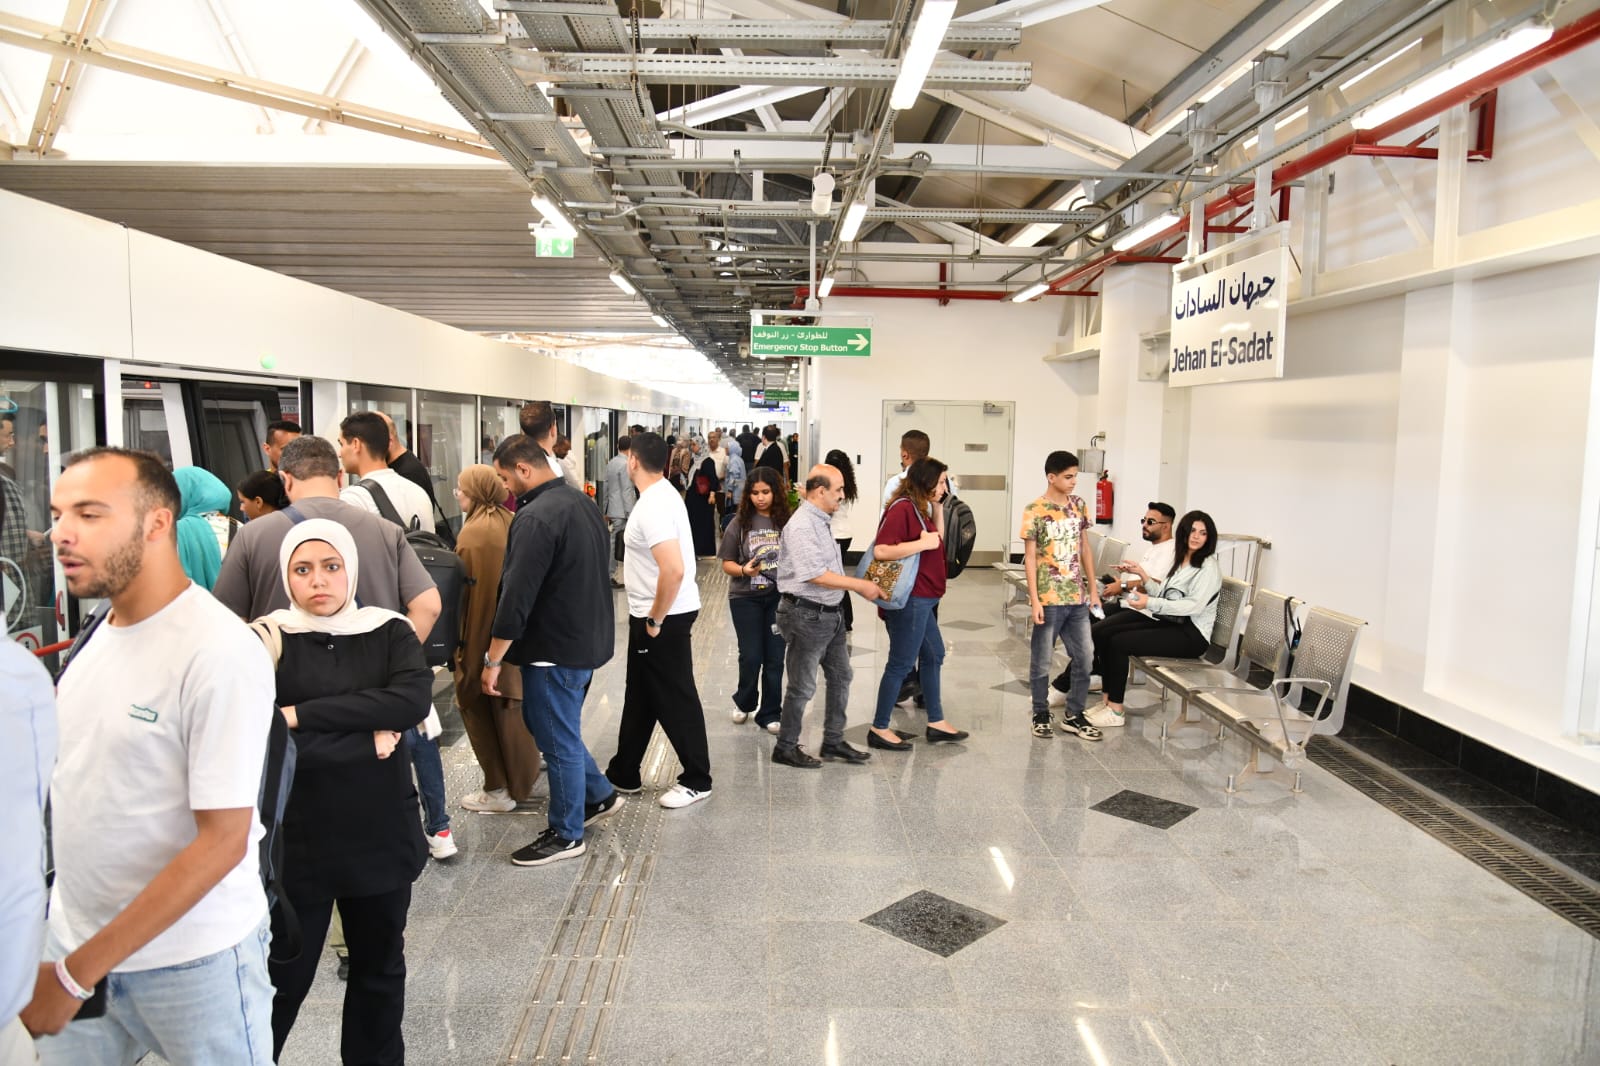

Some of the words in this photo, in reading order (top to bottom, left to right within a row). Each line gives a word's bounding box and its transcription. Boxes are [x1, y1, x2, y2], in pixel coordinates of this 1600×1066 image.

[1229, 271, 1276, 311] جيهان
[753, 342, 798, 352] Emergency
[800, 343, 819, 353] Stop
[820, 344, 848, 352] Button
[1171, 345, 1207, 373] Jehan
[1210, 331, 1274, 368] El-Sadat
